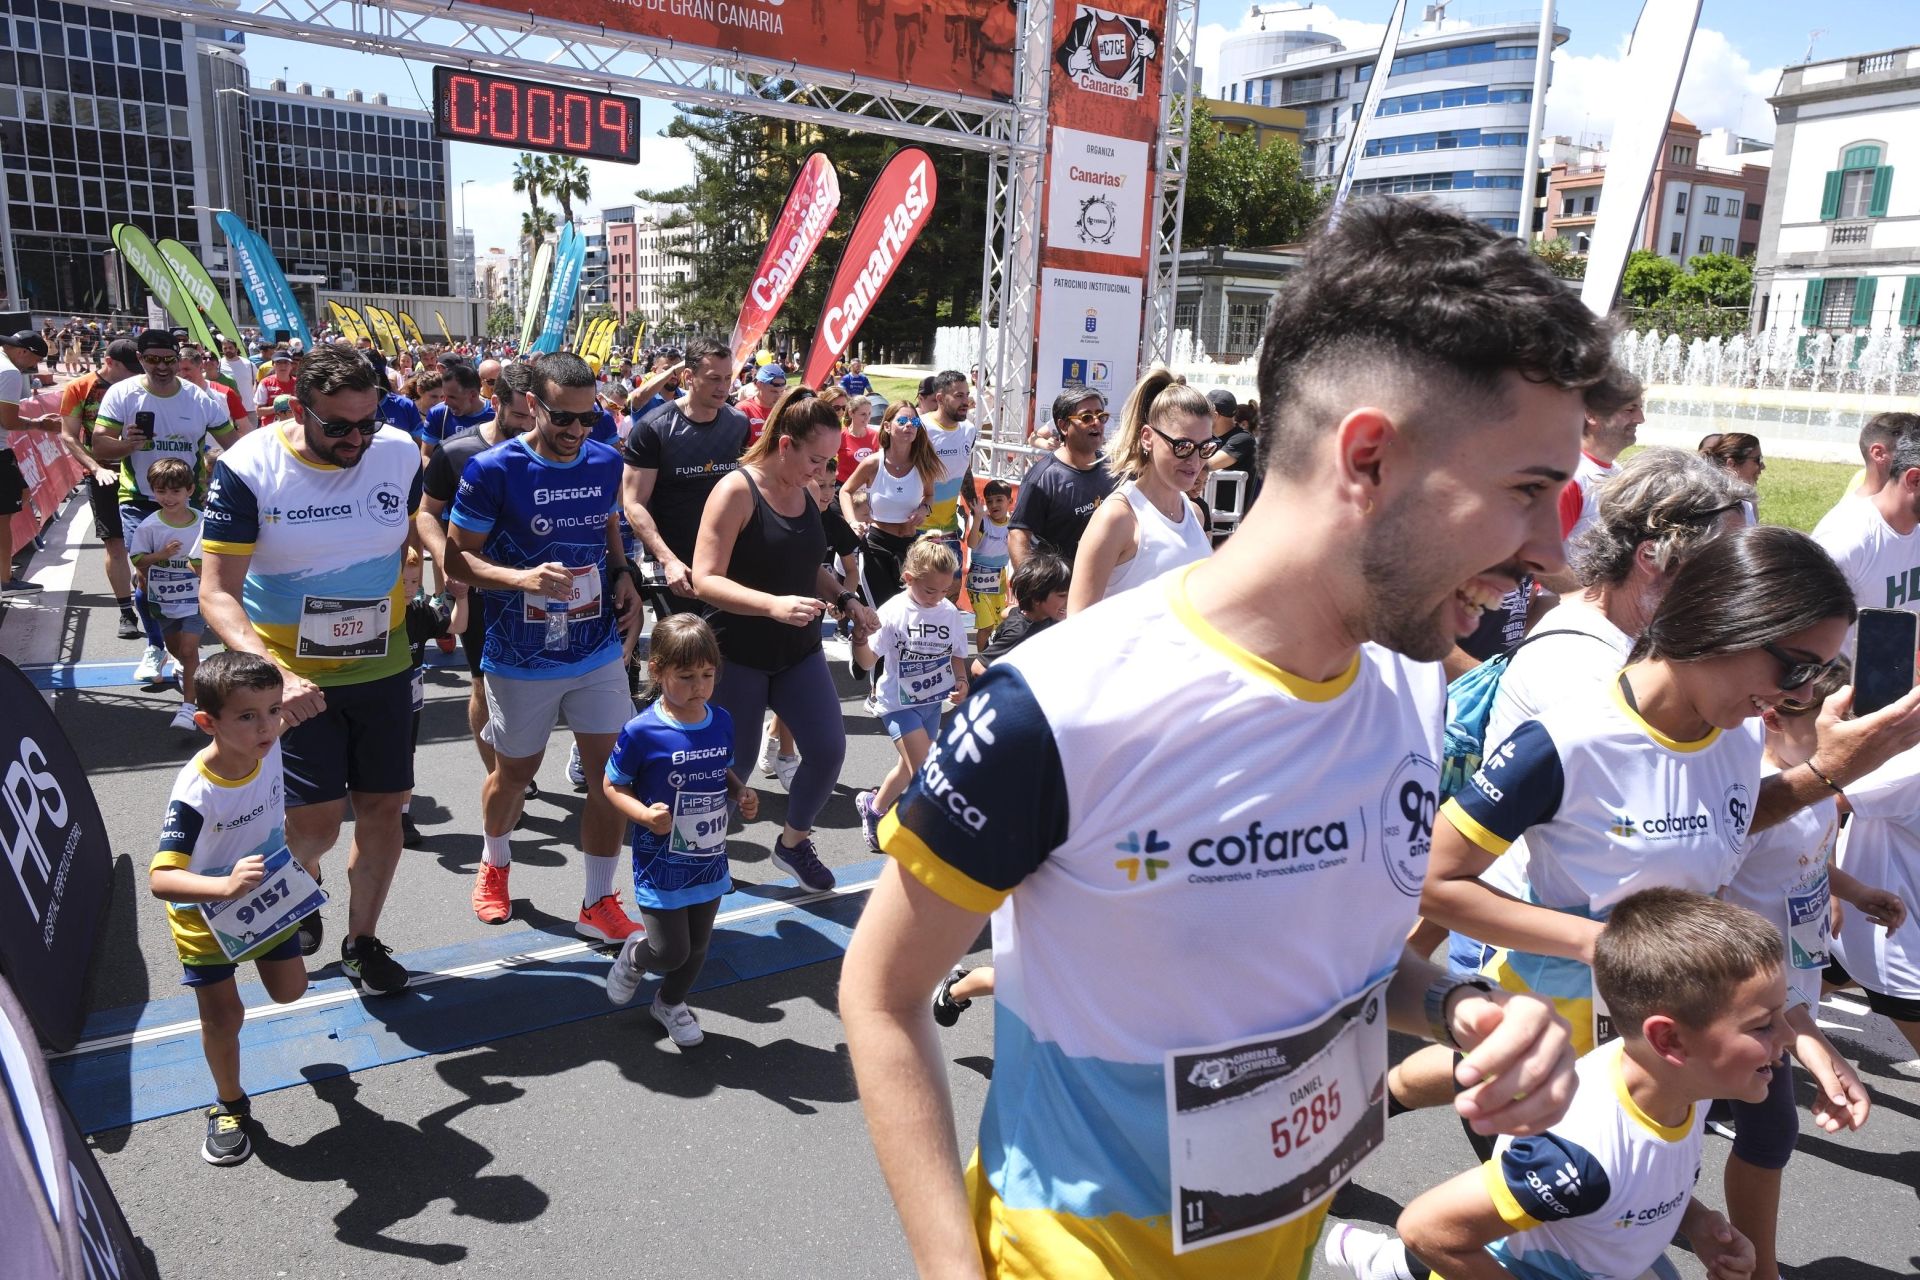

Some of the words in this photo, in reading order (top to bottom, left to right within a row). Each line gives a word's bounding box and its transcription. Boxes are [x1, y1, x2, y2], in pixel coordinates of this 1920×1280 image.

[671, 0, 714, 22] GRAN
[718, 3, 784, 35] CANARIA
[1080, 75, 1135, 98] Canarias7
[1086, 144, 1115, 157] ORGANIZA
[1069, 166, 1128, 188] Canarias7
[752, 169, 831, 312] Canarias7
[823, 159, 929, 355] Canarias7
[1053, 277, 1088, 290] PATROCINIO
[1088, 282, 1132, 295] INSTITUCIONAL
[675, 465, 704, 475] FUND
[287, 505, 352, 520] cofarca
[158, 582, 194, 594] 9205
[333, 620, 364, 637] 5272
[907, 624, 950, 640] HPS
[911, 672, 943, 693] 9033
[226, 805, 264, 828] cofaca
[1643, 812, 1708, 833] cofarca
[0, 736, 69, 924] HPS
[1188, 820, 1349, 868] cofarca
[1188, 872, 1253, 884] Cooperativa
[236, 877, 290, 926] 9157
[1290, 1076, 1323, 1106] DANIEL
[1271, 1080, 1342, 1159] 5285
[1186, 1200, 1203, 1222] 11
